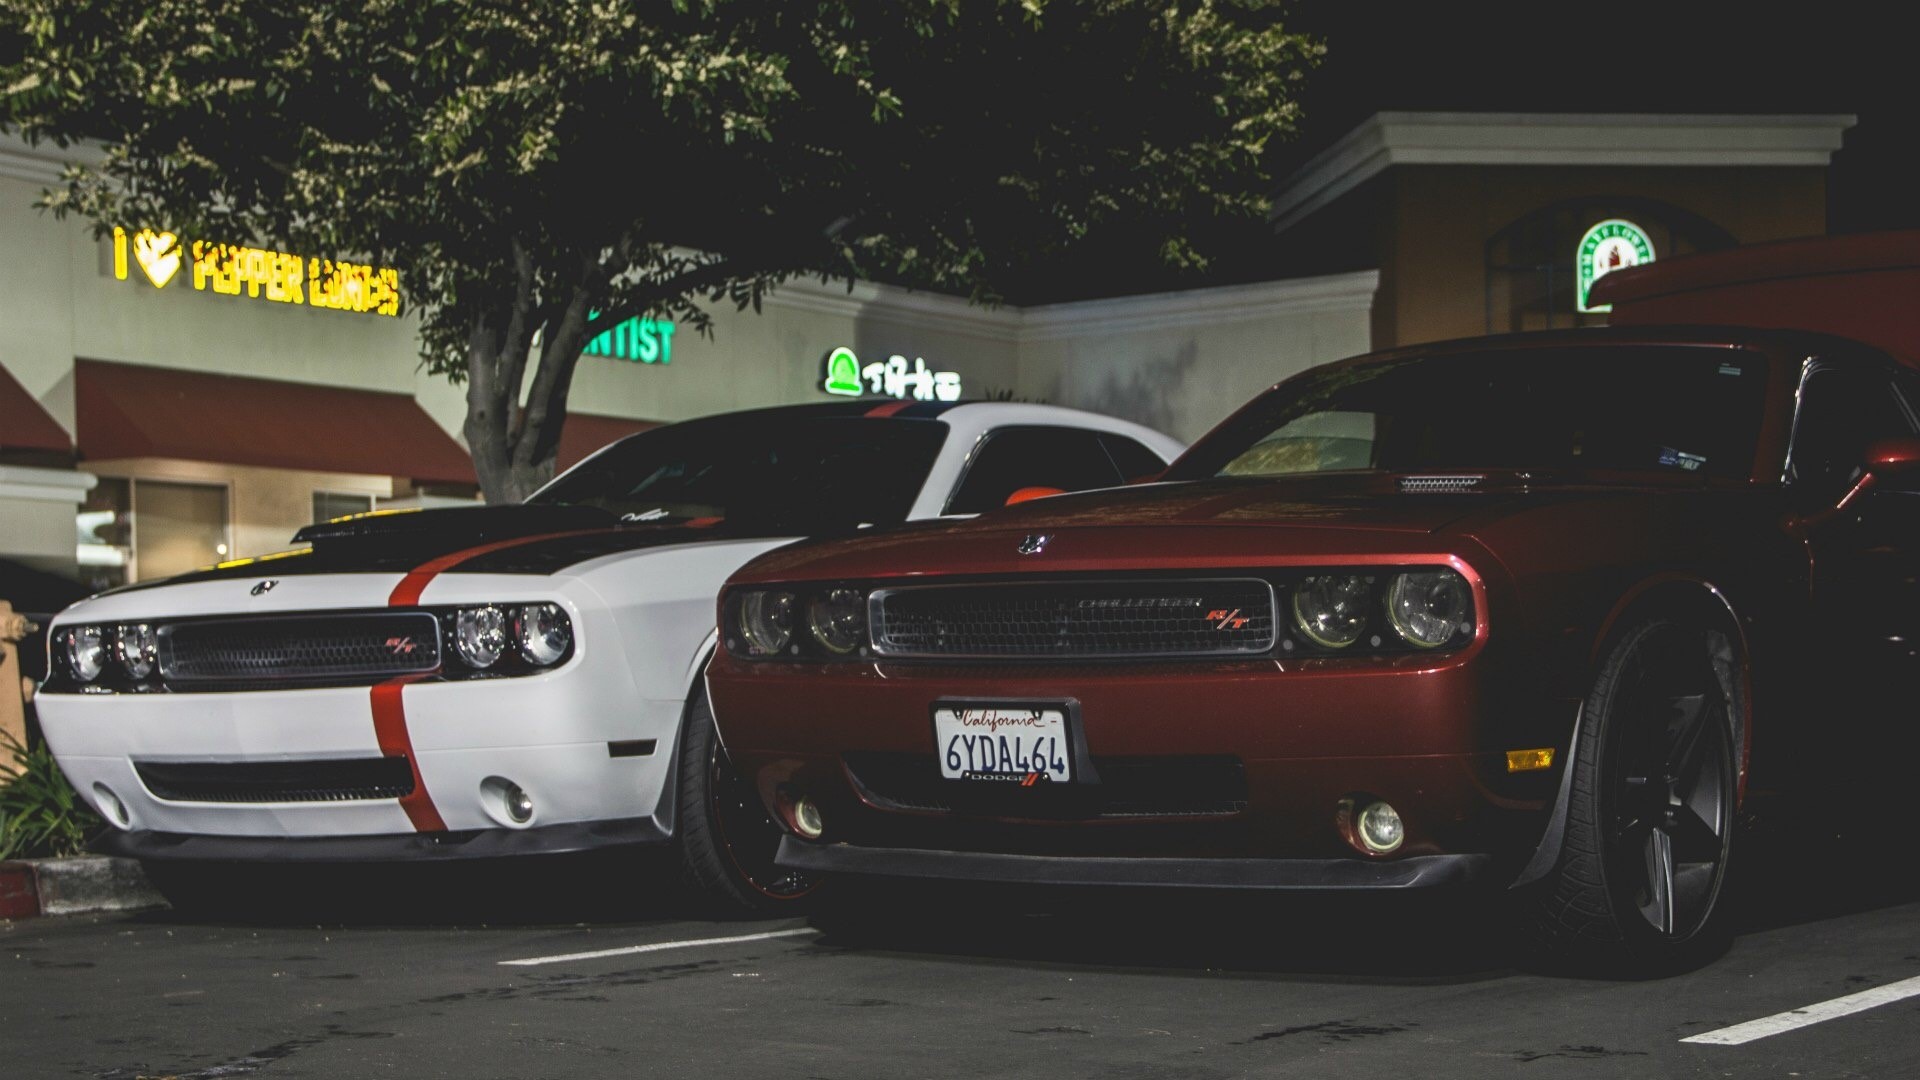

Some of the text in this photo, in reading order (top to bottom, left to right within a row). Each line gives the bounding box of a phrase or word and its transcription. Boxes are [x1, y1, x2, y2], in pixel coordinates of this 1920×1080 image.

[193, 240, 304, 303] PEPPER
[1206, 608, 1250, 630] R/T
[962, 709, 1045, 732] California
[946, 734, 1065, 774] 6YDA464
